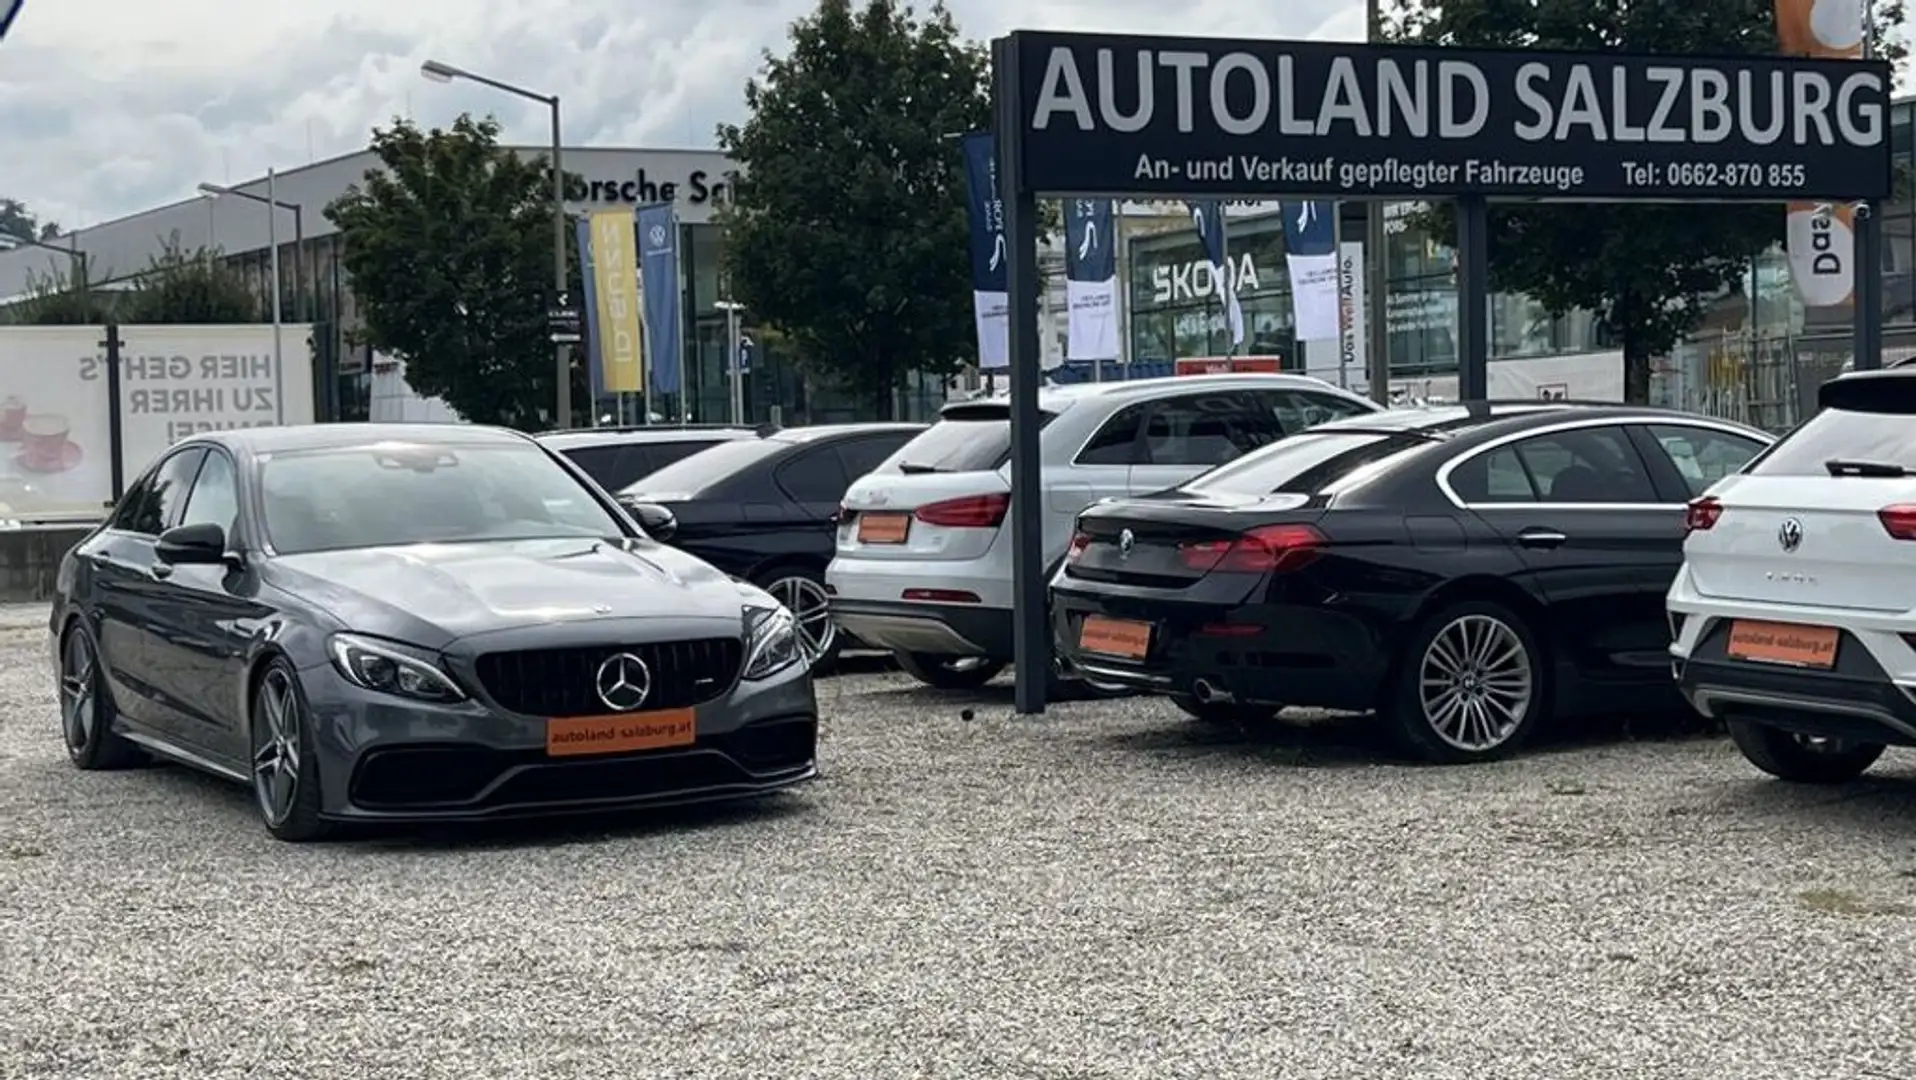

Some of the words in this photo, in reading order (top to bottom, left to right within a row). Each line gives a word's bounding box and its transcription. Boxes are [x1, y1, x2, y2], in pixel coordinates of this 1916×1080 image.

[1032, 47, 1490, 138] AUTOLAND
[1514, 62, 1884, 147] SALZBURG
[1134, 153, 1180, 180] An-
[1187, 155, 1233, 181] und
[1240, 157, 1334, 182] Verkauf
[1340, 158, 1459, 189] gepflegter
[1465, 160, 1585, 190] Fahrzeuge
[1622, 162, 1661, 185] Tel:
[1667, 163, 1763, 187] 0662-870
[1768, 164, 1806, 187] 855
